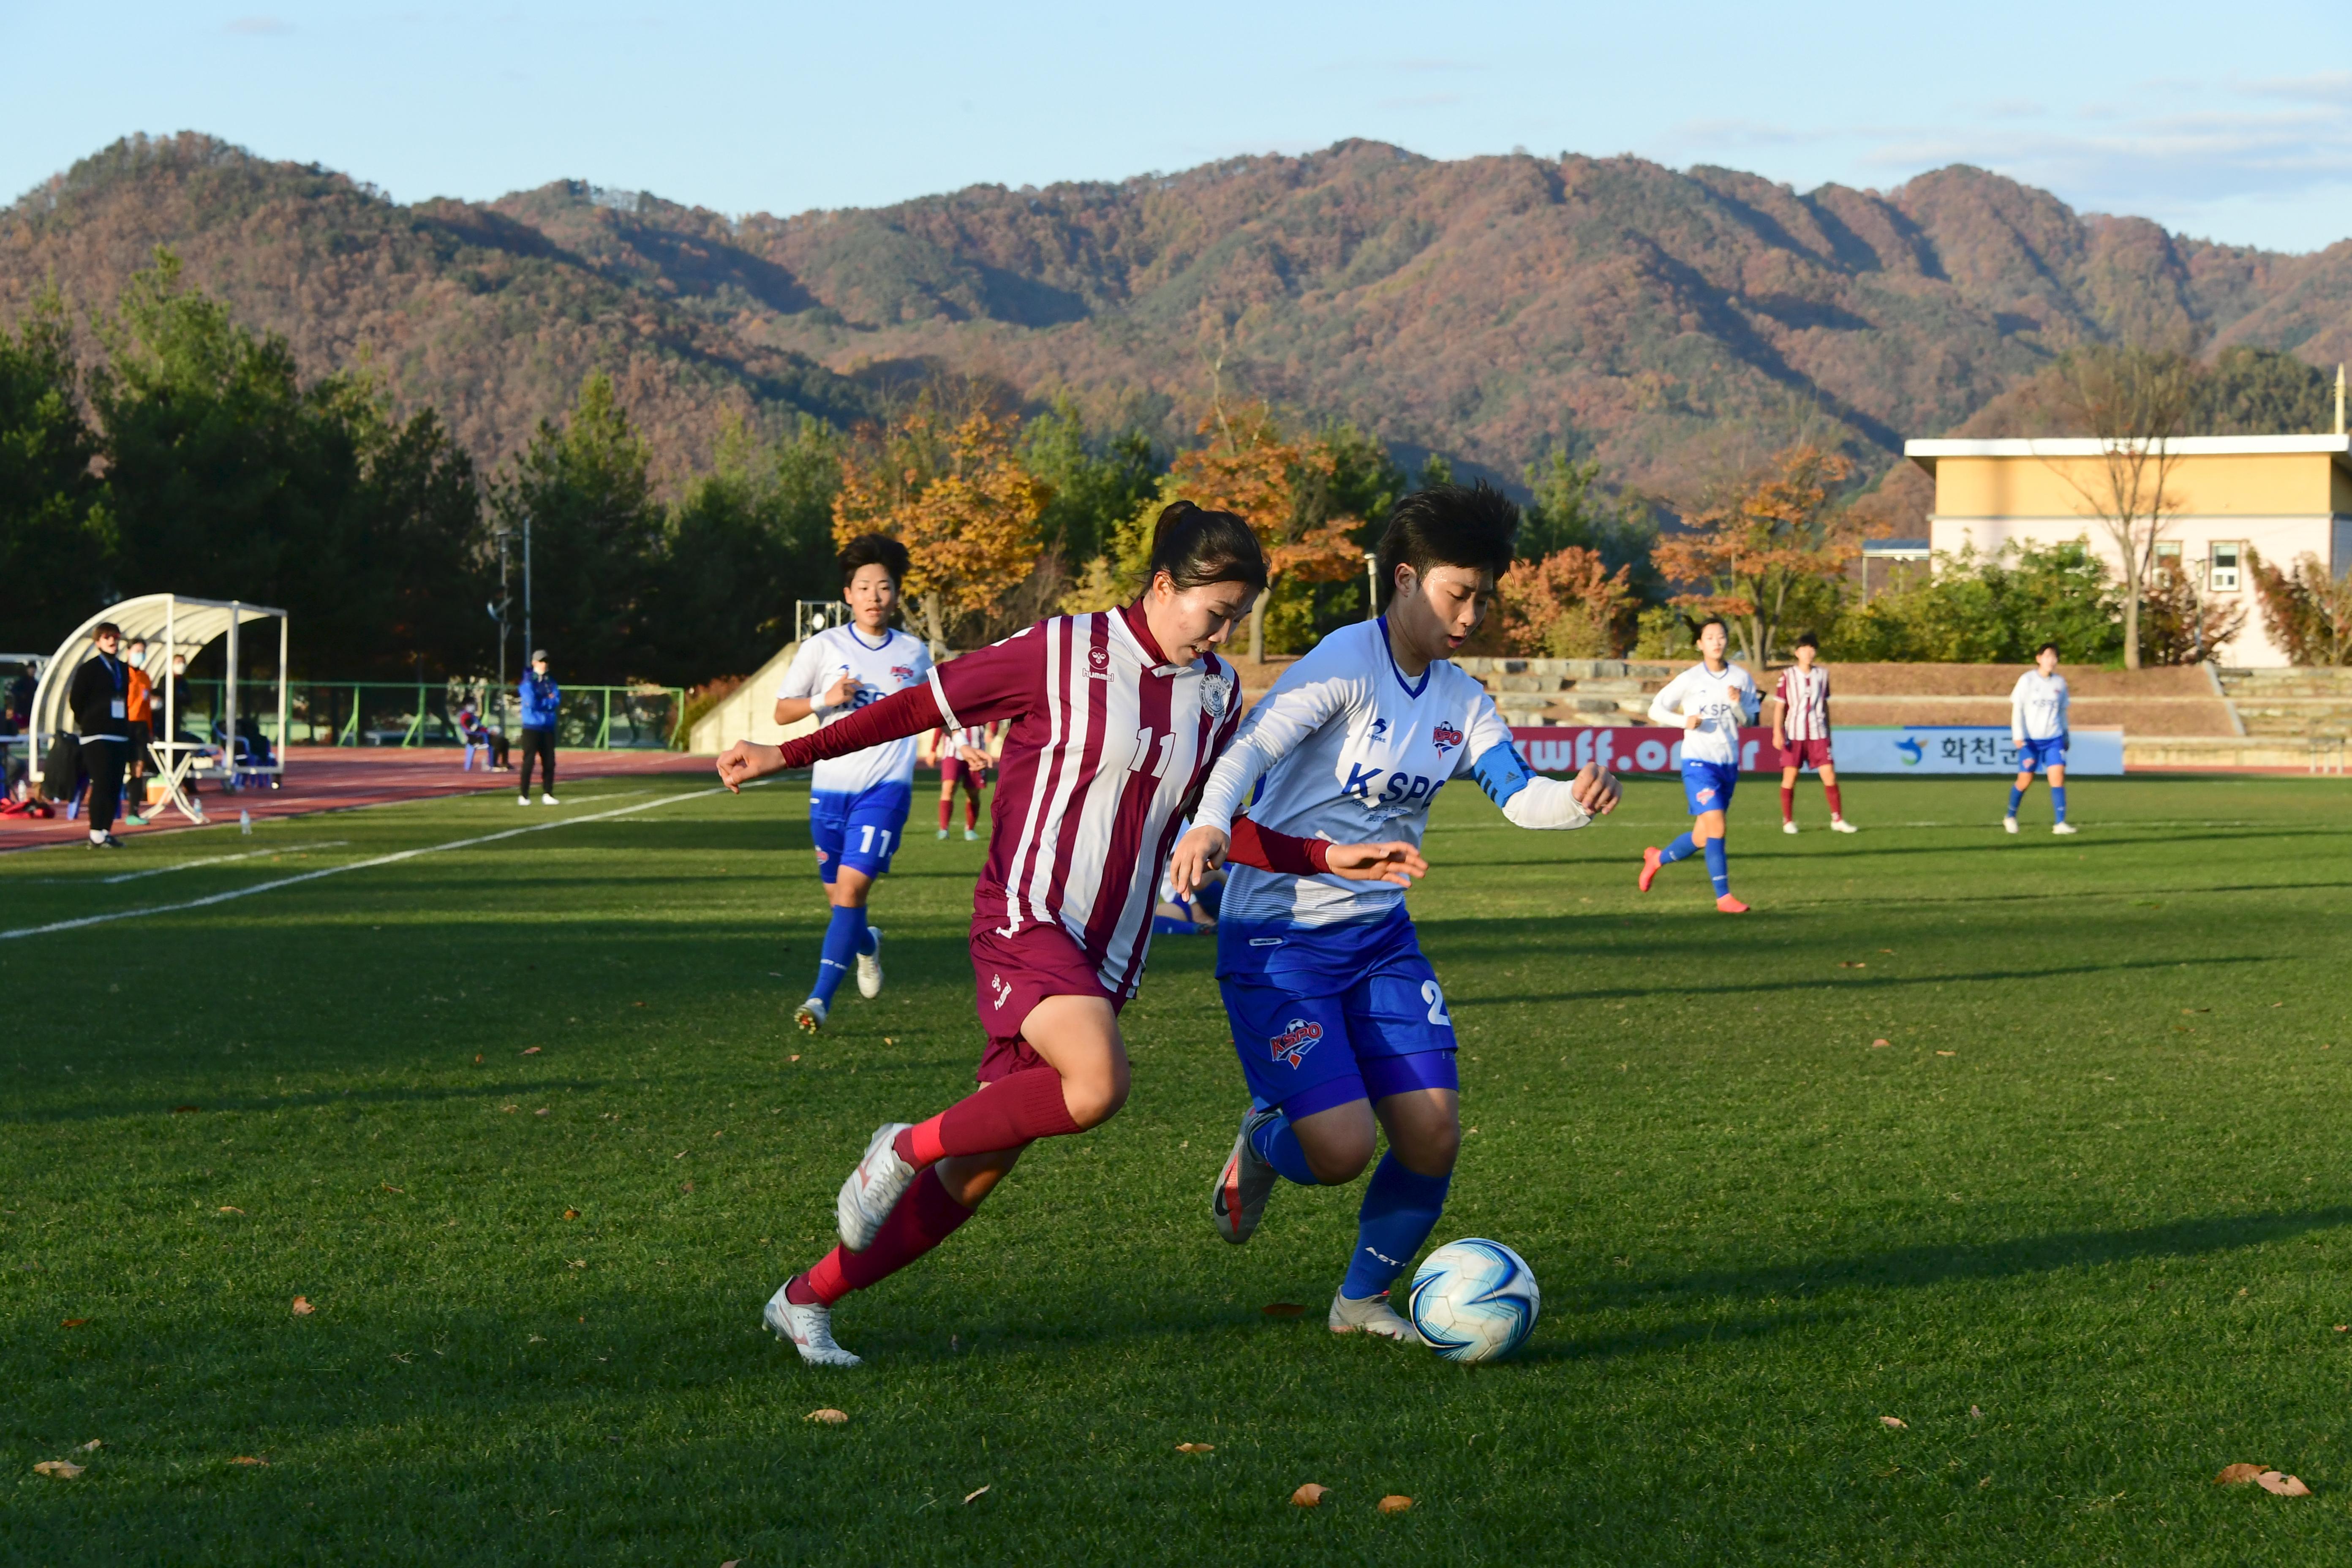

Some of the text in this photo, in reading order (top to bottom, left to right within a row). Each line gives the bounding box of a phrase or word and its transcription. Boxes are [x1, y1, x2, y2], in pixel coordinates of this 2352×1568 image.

[1082, 667, 1114, 682] hummel
[1699, 704, 1731, 716] KSP
[1432, 726, 1463, 746] KSPO
[1127, 726, 1176, 779] 11
[1941, 738, 2018, 765] 화천군
[859, 825, 892, 858] 11
[1271, 1023, 1323, 1059] KSPO
[1365, 1247, 1406, 1267] AST
